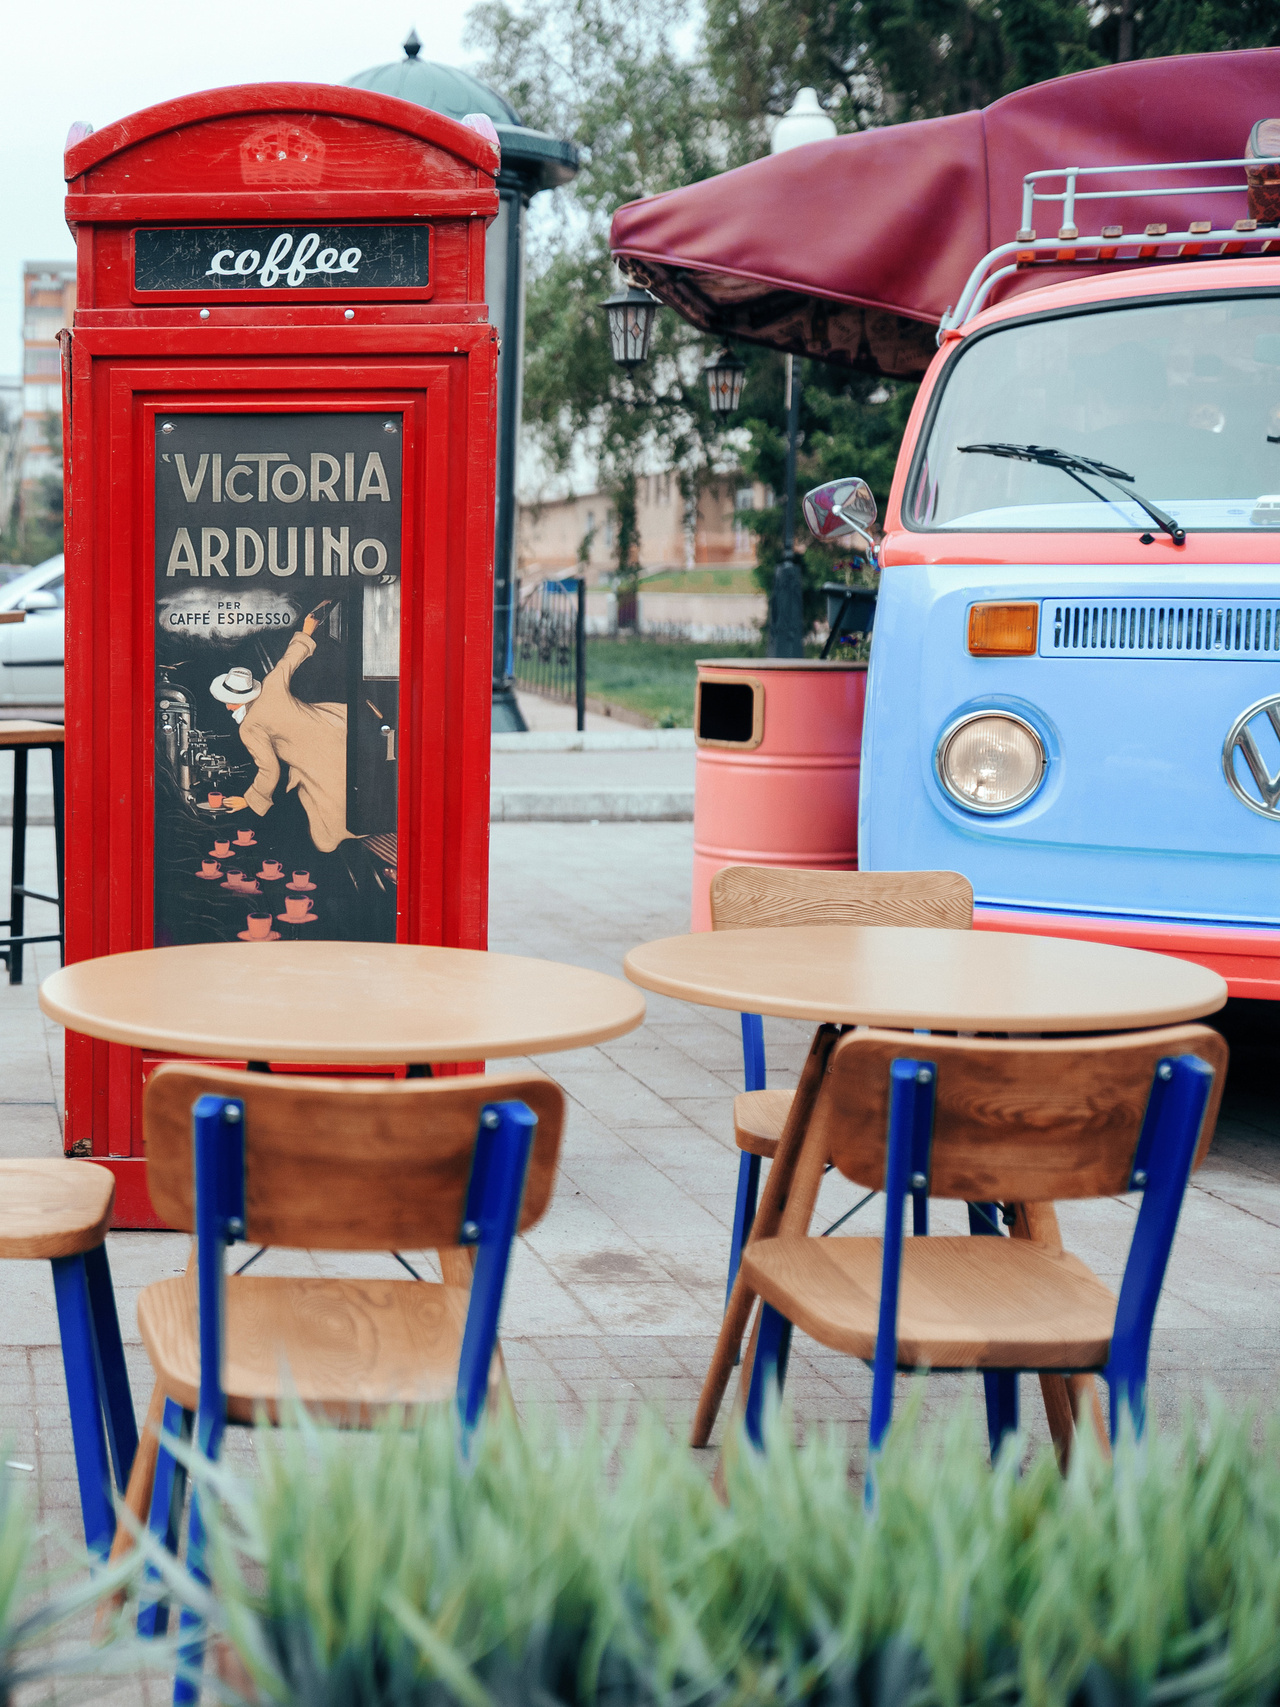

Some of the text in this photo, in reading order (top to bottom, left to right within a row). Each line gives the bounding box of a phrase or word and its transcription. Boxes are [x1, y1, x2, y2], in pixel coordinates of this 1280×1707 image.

[205, 232, 362, 288] coffee
[217, 601, 241, 610] PER
[169, 610, 291, 625] CAFFÉ ESPRESSO
